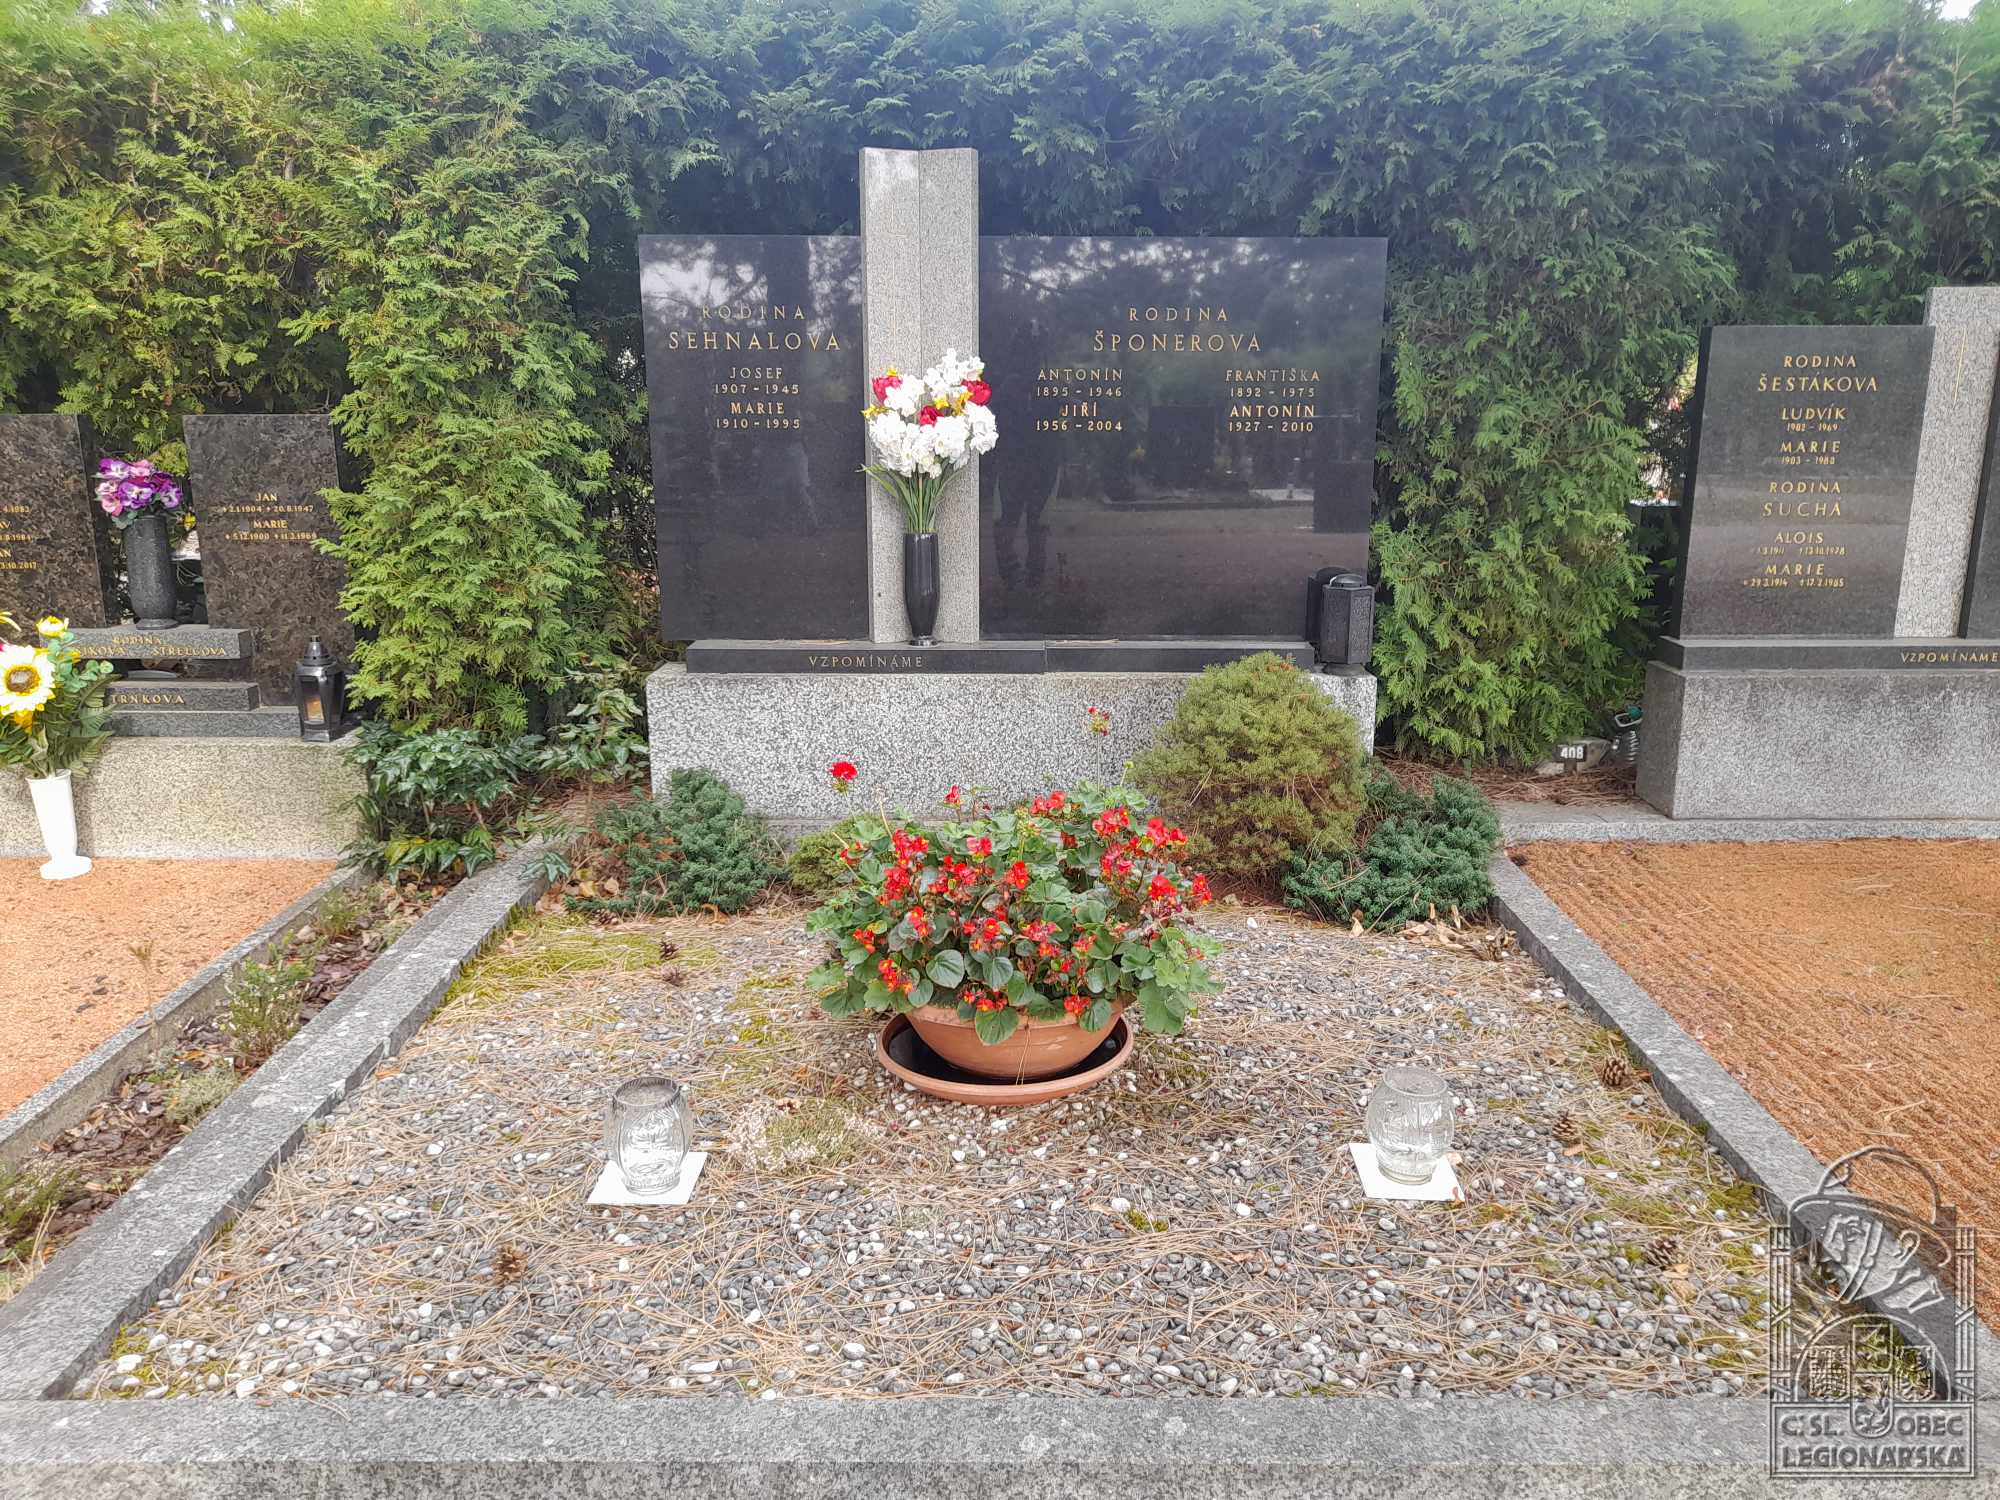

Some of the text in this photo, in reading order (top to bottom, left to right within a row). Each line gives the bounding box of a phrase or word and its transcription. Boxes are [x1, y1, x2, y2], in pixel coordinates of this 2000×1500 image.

[702, 305, 805, 320] RODINA
[1129, 306, 1228, 322] RODINA
[668, 332, 840, 350] SEHNALOVA
[1783, 354, 1857, 368] RODINA
[729, 367, 783, 379] JOSEF
[1225, 368, 1320, 382] FRANTIŠKA
[1758, 371, 1878, 393] ŠESTÁKOVA
[714, 384, 747, 395] 1907
[765, 384, 800, 395] 1945
[1036, 386, 1069, 397] 1895
[1089, 386, 1122, 397] 1946
[1230, 387, 1261, 398] 1892
[1282, 387, 1315, 398] 1975
[730, 402, 785, 415] MARIE
[1061, 401, 1098, 417] JIŘÍ
[1230, 402, 1315, 418] ANTONÍN
[1781, 403, 1847, 421] LUDVÍK
[716, 419, 748, 429] 1910
[766, 419, 800, 429] 1995
[1036, 420, 1068, 431] 1956
[1087, 420, 1123, 431] 2004
[1229, 421, 1261, 432] 1927
[1281, 421, 1313, 432] 2010
[1780, 441, 1841, 454] MARIE
[1768, 481, 1841, 494] RODINA
[255, 492, 278, 502] JAN
[253, 519, 289, 529] MARIE
[1774, 531, 1826, 545] ALOIS
[1764, 563, 1825, 576] MARIE
[808, 654, 923, 668] VZPOMÍNÁME
[1901, 648, 1999, 663] VZPOMÍNÁME
[1560, 746, 1584, 759] 408
